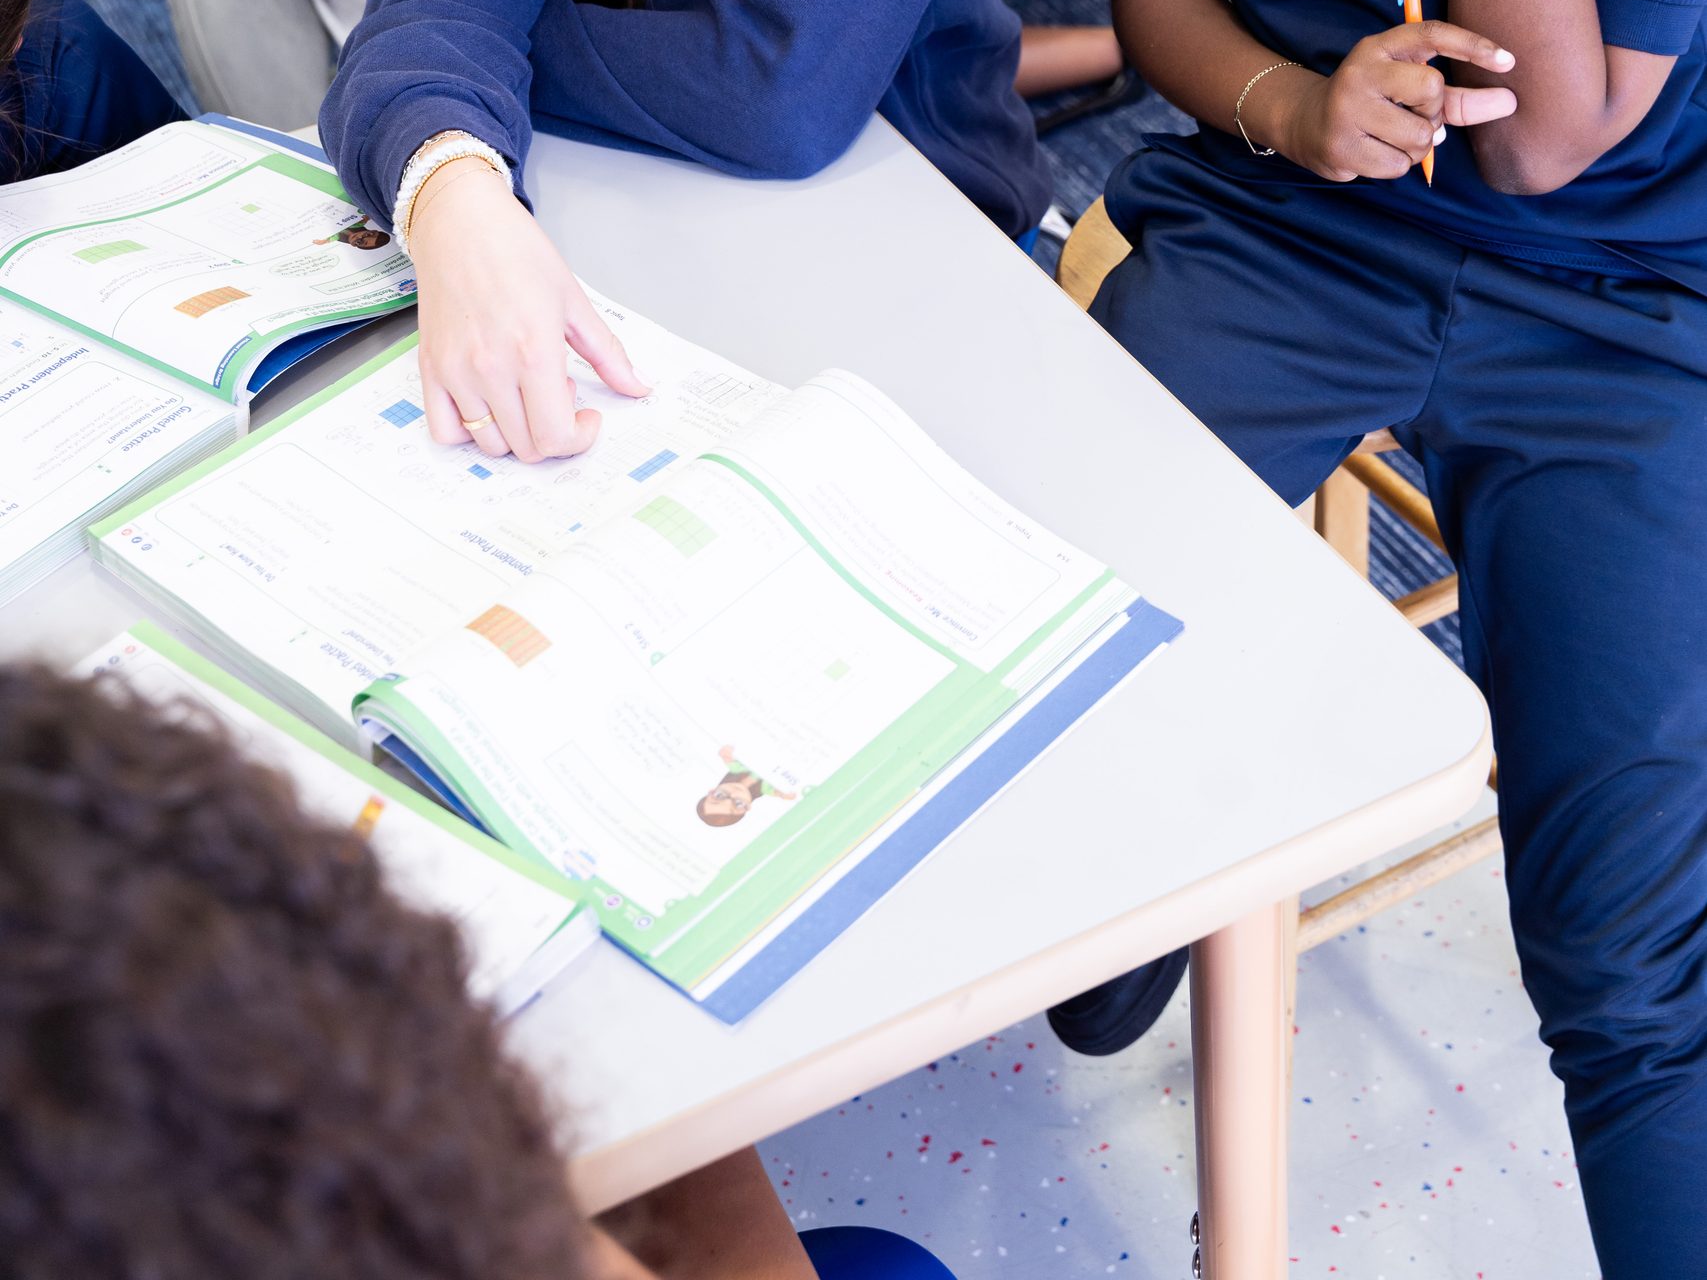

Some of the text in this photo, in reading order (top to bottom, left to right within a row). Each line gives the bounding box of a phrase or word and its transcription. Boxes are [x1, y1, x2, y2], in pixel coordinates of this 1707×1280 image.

[27, 342, 90, 385] Independent
[104, 394, 178, 445] Do You Understand?
[156, 402, 193, 430] Guided
[119, 423, 160, 455] Practice
[458, 525, 534, 577] ependent Practice
[939, 613, 979, 644] Convince
[318, 639, 355, 669] Practice
